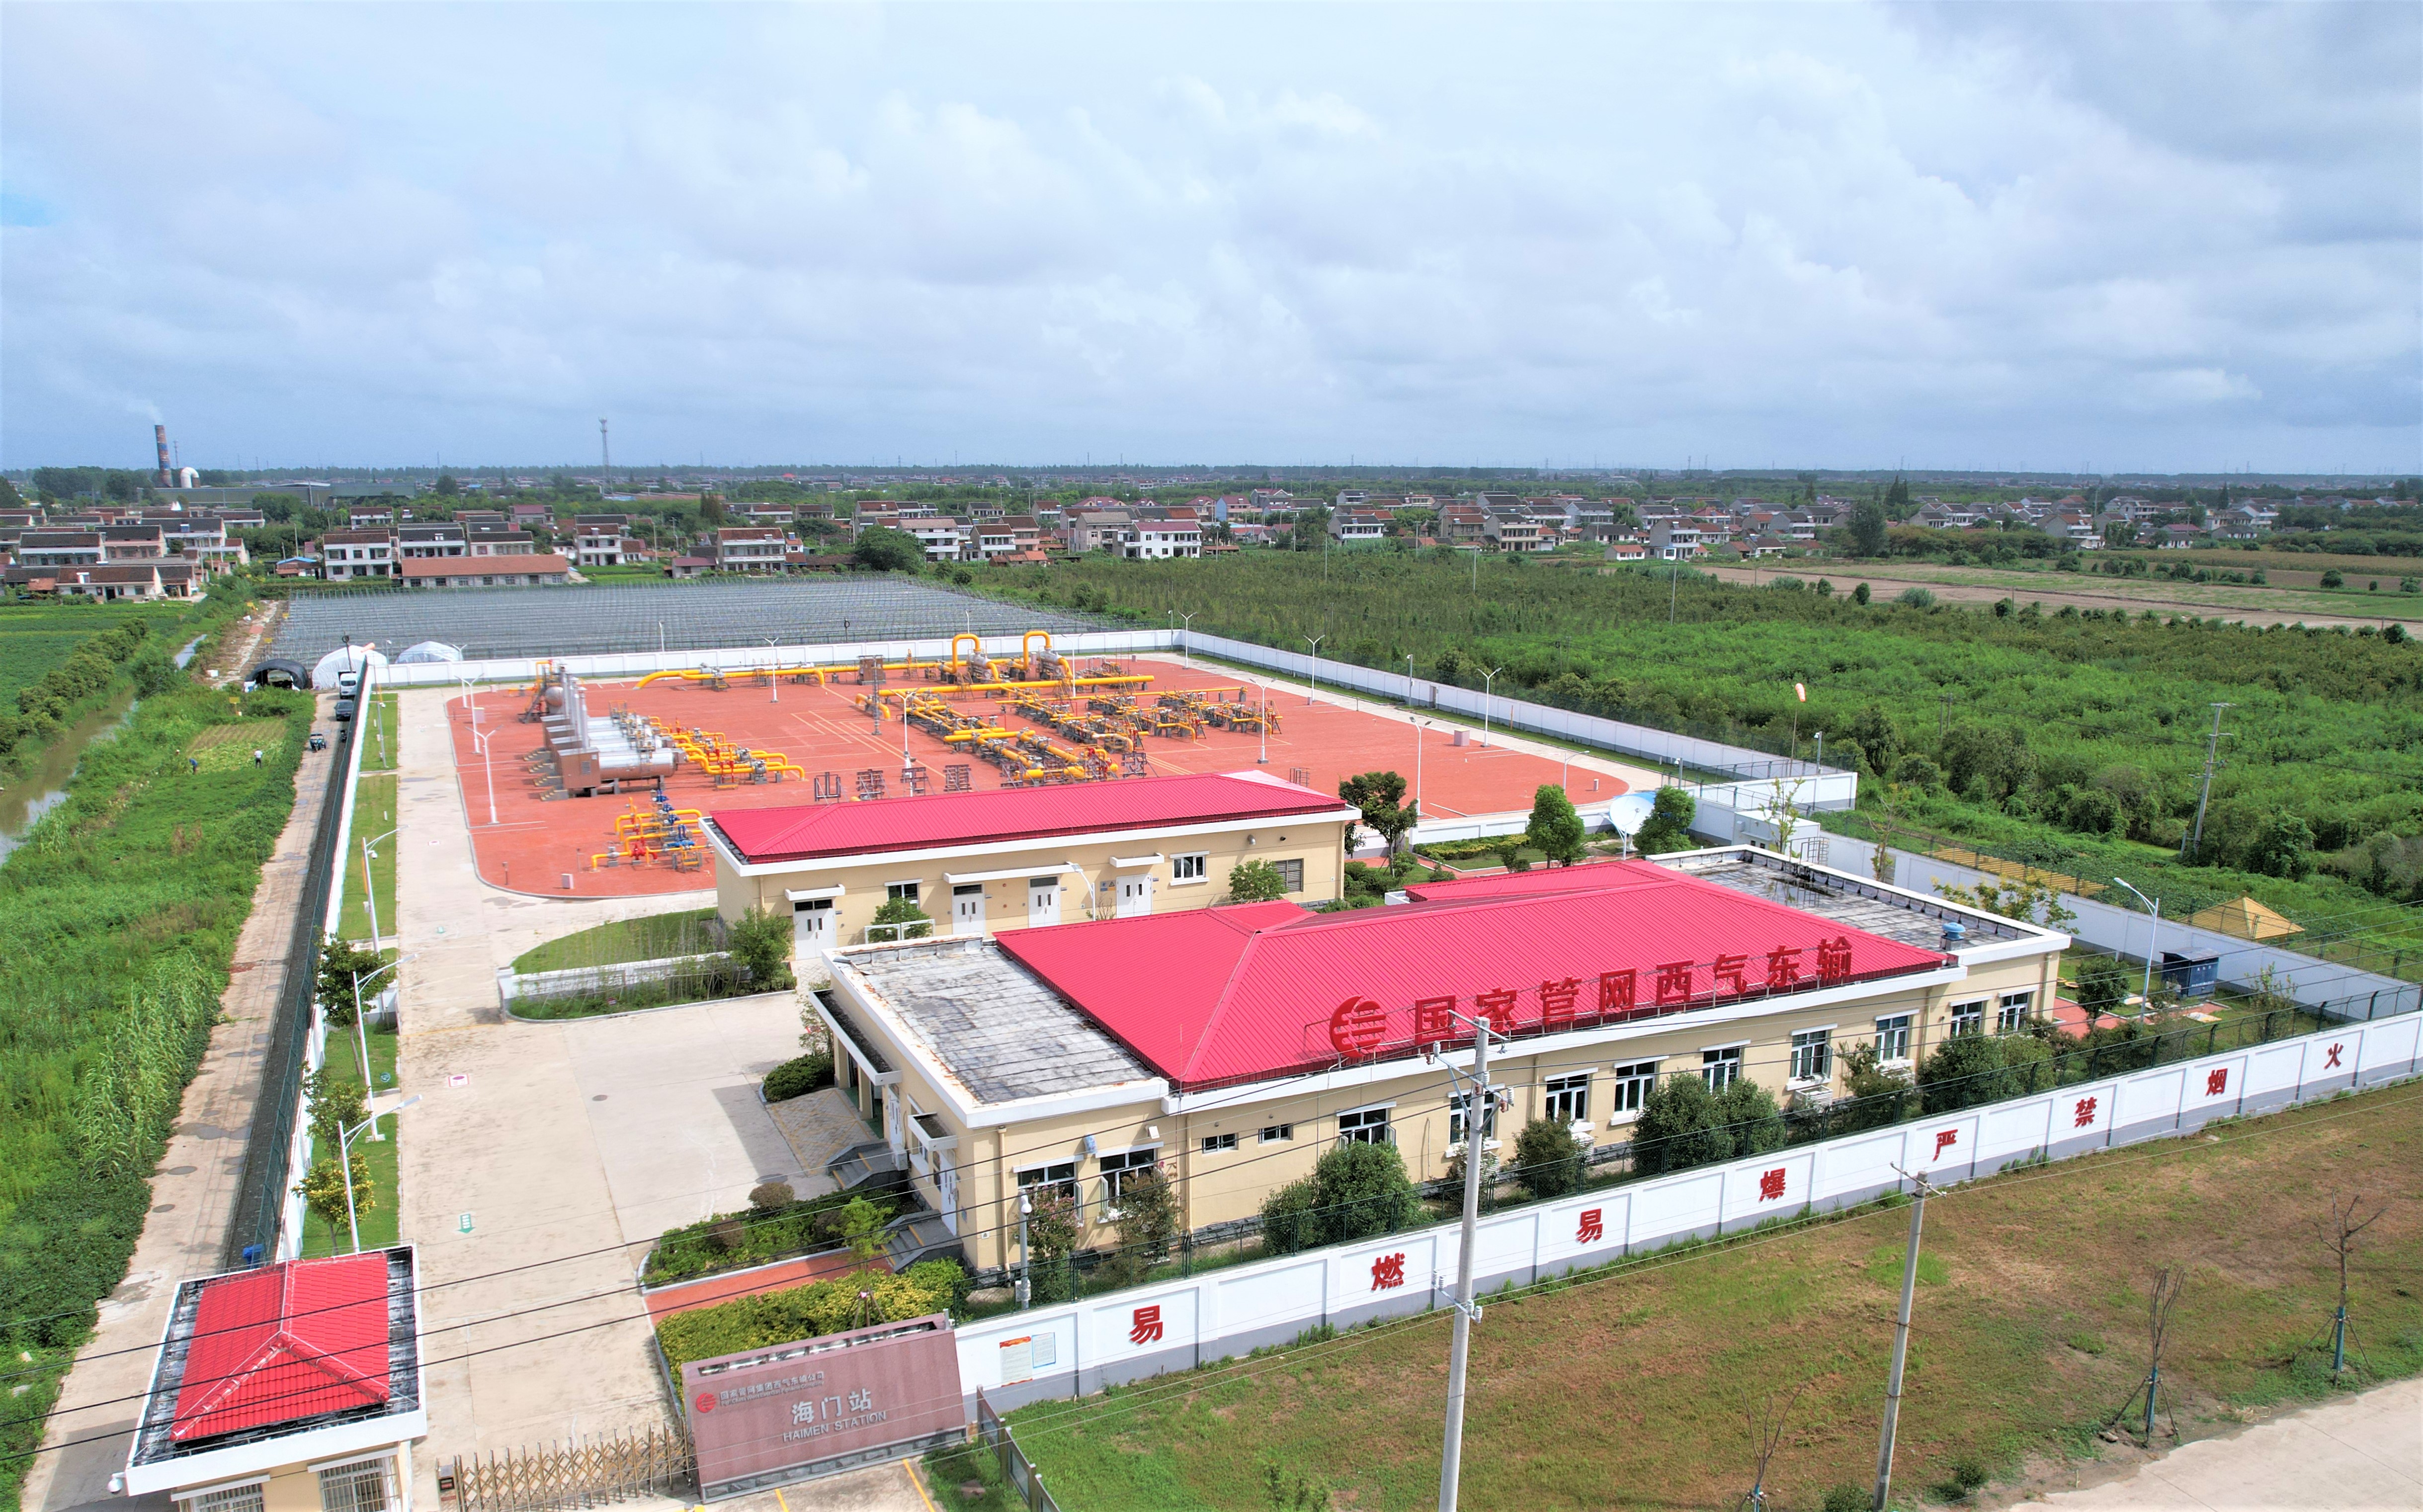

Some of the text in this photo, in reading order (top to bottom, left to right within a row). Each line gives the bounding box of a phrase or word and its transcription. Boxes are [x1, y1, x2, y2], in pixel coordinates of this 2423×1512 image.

[1414, 935, 1853, 1046] 国家管网西气东输
[721, 1371, 824, 1400] 国家管网集团西气东输公司
[791, 1388, 872, 1425] 海门站
[782, 1410, 887, 1442] HAIMEN STATION
